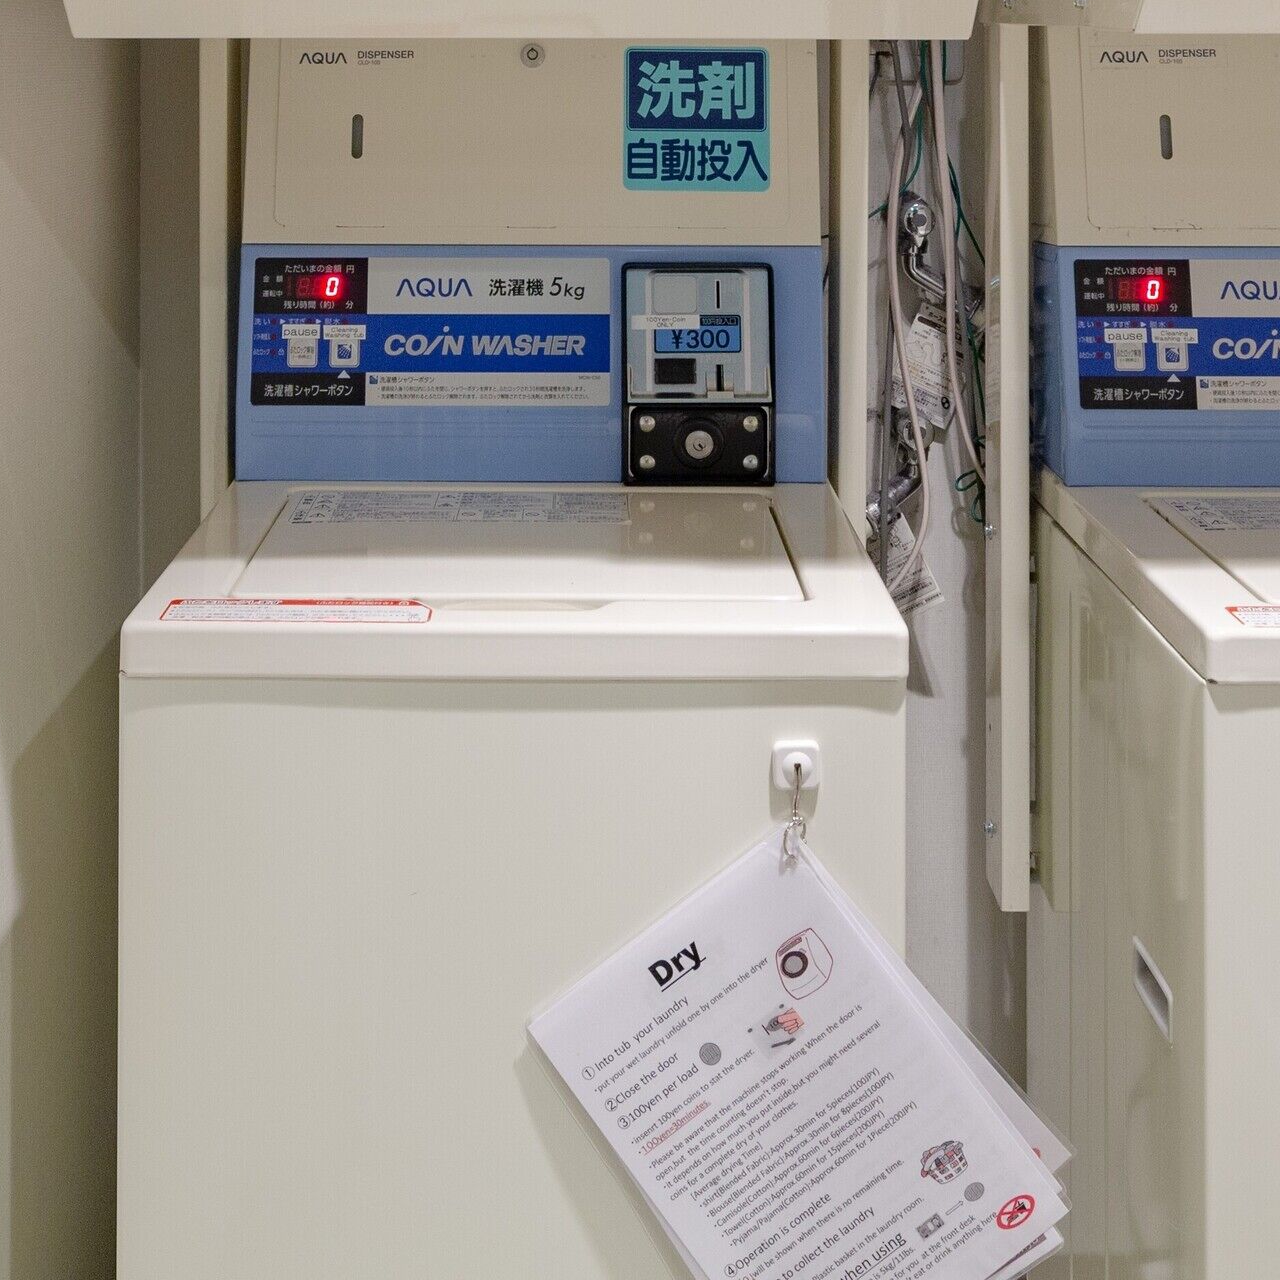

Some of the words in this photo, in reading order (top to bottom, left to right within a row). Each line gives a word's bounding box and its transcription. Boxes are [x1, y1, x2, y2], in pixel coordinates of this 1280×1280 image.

[299, 51, 348, 65] AQUA
[357, 50, 414, 60] DISPENSER
[1099, 51, 1149, 64] AQUA
[1158, 48, 1217, 59] DISPENSER
[637, 60, 758, 120] 洗剤
[627, 138, 768, 182] 自動投入
[325, 276, 340, 296] 0
[396, 277, 473, 297] AQUA
[488, 278, 544, 297] 洗濯機
[549, 276, 585, 300] 5kg
[1146, 280, 1160, 300] 0
[283, 328, 318, 337] pause
[384, 325, 465, 356] COIN
[472, 335, 586, 356] WASHER
[671, 330, 730, 349] ¥300
[1107, 332, 1143, 341] pause
[263, 384, 354, 398] 洗濯槽シャワーボタン
[1093, 388, 1185, 401] 洗濯槽シャワーボタン
[648, 942, 706, 991] Dry
[594, 1054, 614, 1071] Into
[614, 1041, 631, 1056] tub
[633, 1023, 653, 1043] your
[653, 997, 688, 1025] laundry
[640, 1070, 657, 1085] the
[657, 1053, 678, 1072] door
[662, 1081, 677, 1098] per
[676, 1063, 699, 1083] load
[673, 1142, 684, 1151] be
[684, 1125, 705, 1144] aware
[704, 1114, 720, 1127] that
[718, 1105, 732, 1116] the
[732, 1083, 761, 1107] machine
[760, 1068, 779, 1085] stops
[778, 1047, 807, 1070] working
[804, 1032, 827, 1049] When
[826, 1022, 839, 1034] the
[839, 1009, 855, 1024] door
[779, 1226, 790, 1236] is
[790, 1194, 831, 1228] complete
[794, 1246, 824, 1272] collect
[823, 1234, 840, 1249] the
[838, 1207, 874, 1236] laundry
[872, 1233, 907, 1265] using
